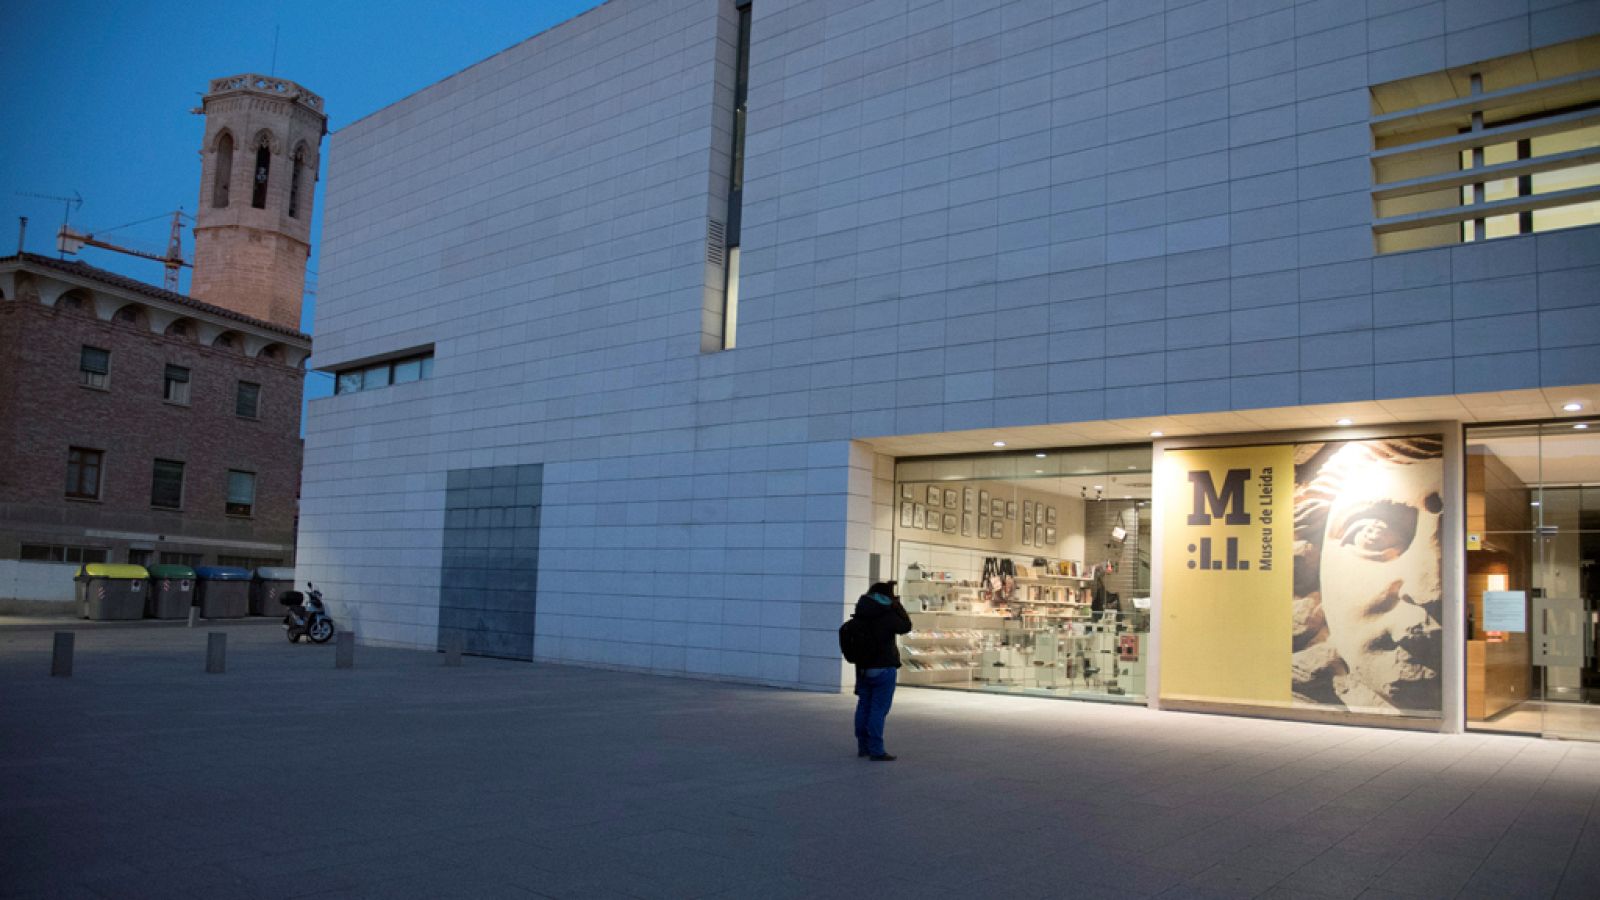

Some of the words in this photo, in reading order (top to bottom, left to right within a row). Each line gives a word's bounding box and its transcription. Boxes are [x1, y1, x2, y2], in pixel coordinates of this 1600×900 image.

[1187, 469, 1251, 525] M
[1258, 467, 1273, 505] Lleida
[1259, 508, 1273, 525] de
[1259, 528, 1273, 571] Museu
